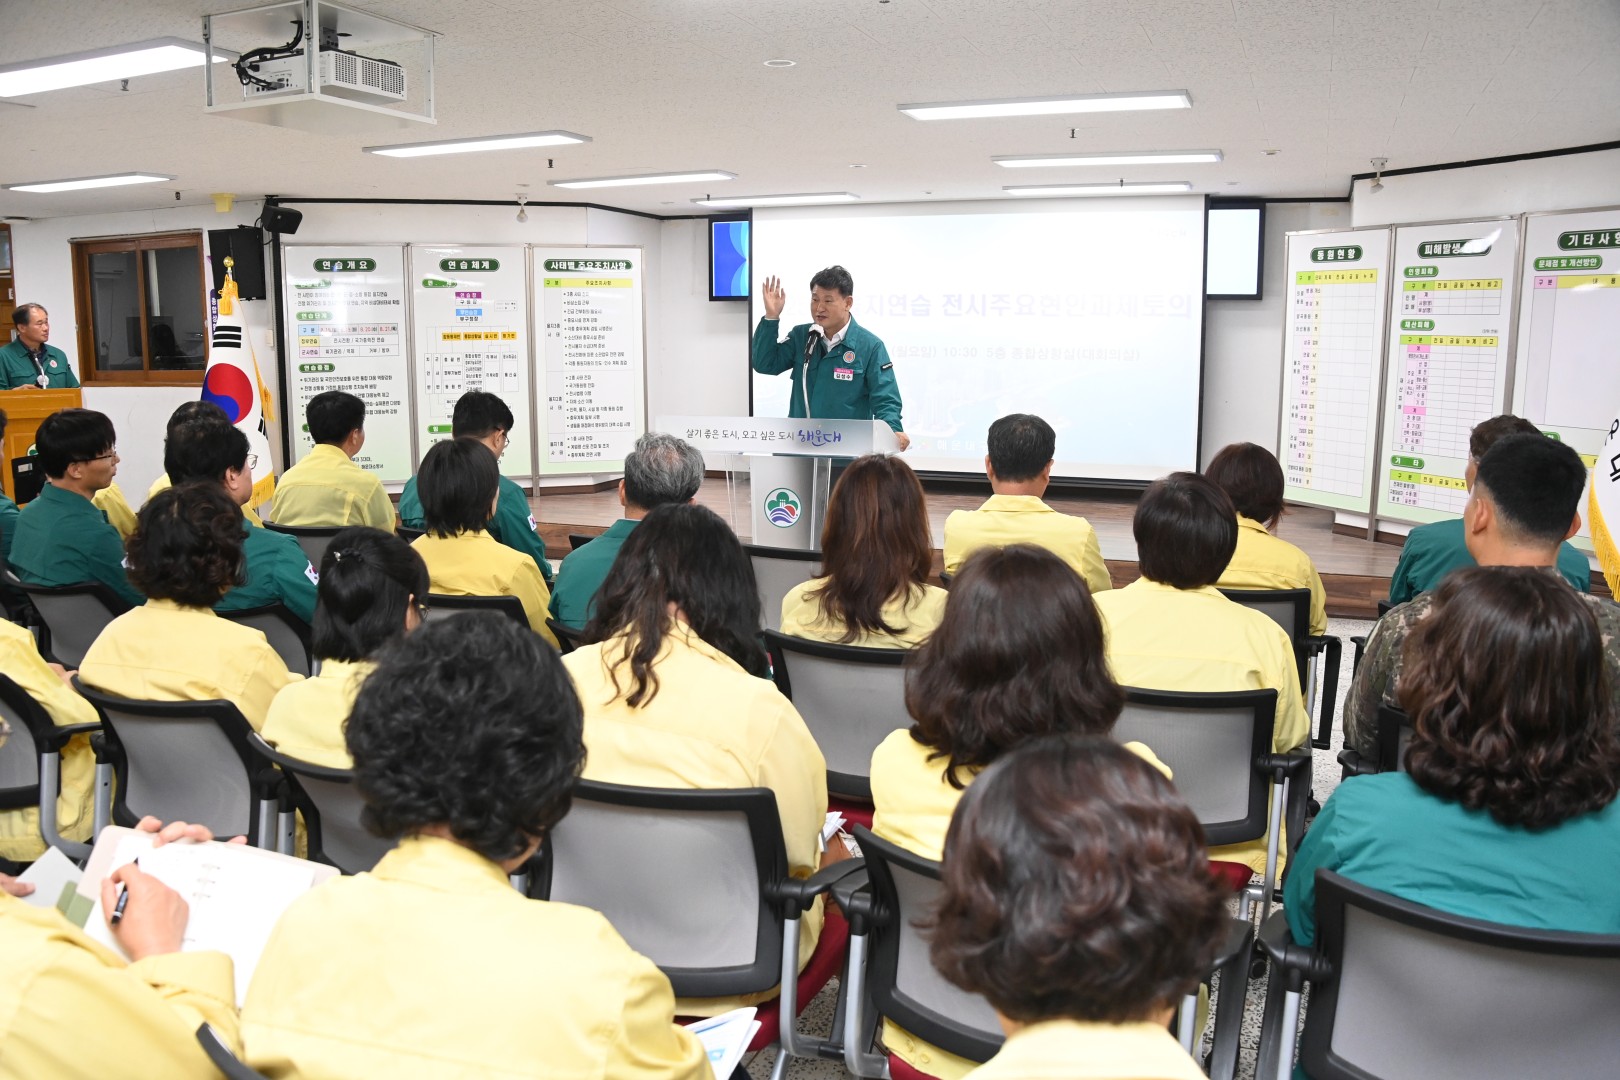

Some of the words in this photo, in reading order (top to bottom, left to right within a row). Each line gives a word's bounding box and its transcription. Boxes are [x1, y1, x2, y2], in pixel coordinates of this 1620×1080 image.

[1318, 249, 1355, 260] 동원현황
[322, 261, 367, 270] 연습개요
[448, 261, 490, 270] 연습체계
[551, 261, 575, 269] 사태별
[578, 261, 626, 270] 주요조치사항
[1539, 259, 1558, 268] 문제점
[1560, 259, 1567, 267] 및
[1569, 258, 1598, 267] 개선방안
[1409, 268, 1434, 276] 인명피해
[857, 293, 931, 317] 지연습
[944, 346, 978, 358] 10:30
[986, 346, 1007, 360] 5층
[686, 428, 702, 438] 살기
[704, 429, 720, 439] 좋은
[721, 429, 740, 440] 도시,
[741, 430, 758, 440] 오고
[760, 430, 776, 441] 싶은
[778, 431, 794, 441] 도시
[797, 428, 842, 447] 해운대
[1395, 457, 1419, 466] 기타
